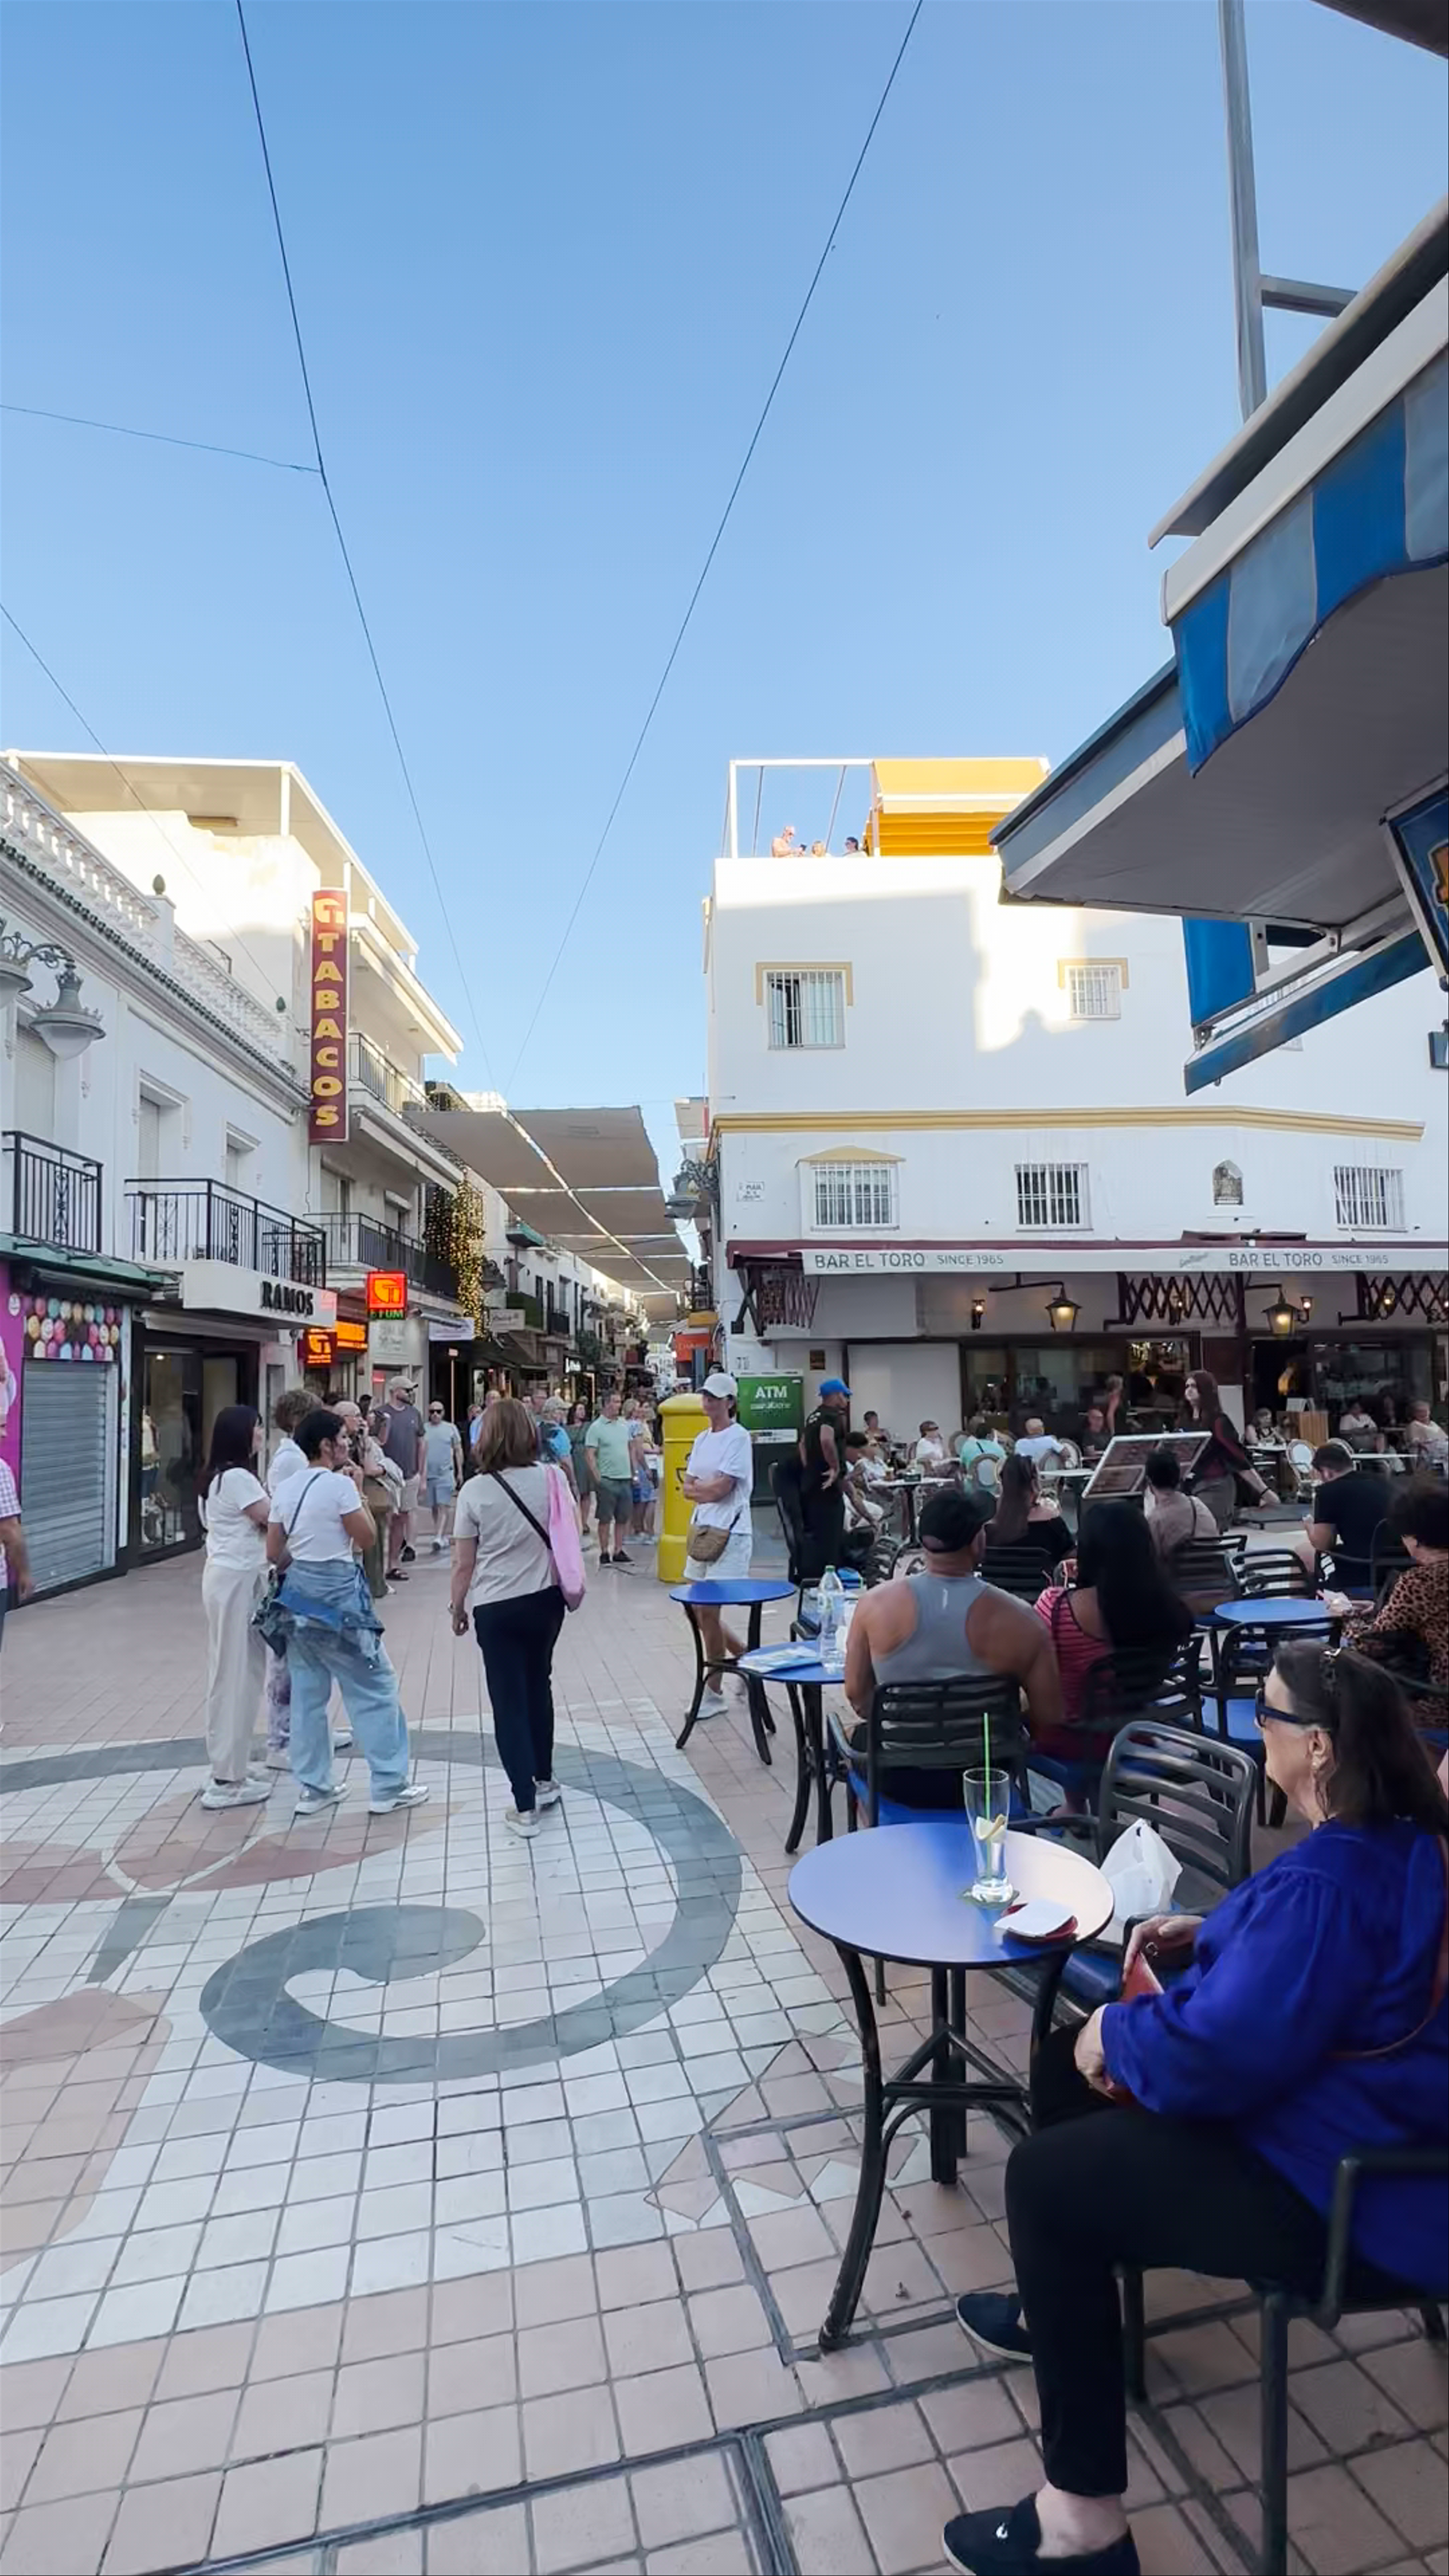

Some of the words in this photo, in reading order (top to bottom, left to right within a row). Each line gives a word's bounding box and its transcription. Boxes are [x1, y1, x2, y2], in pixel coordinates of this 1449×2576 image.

[313, 932, 343, 1126] TABACOS
[814, 1254, 849, 1268] BAR
[855, 1254, 874, 1267] EL
[879, 1252, 925, 1267] TORO
[937, 1255, 974, 1265] SINCE
[978, 1255, 1004, 1264] 1965
[1229, 1253, 1258, 1266] BAR
[1263, 1253, 1280, 1267] EL
[1283, 1253, 1322, 1267] TORO
[1332, 1255, 1362, 1264] SINCE
[261, 1280, 314, 1316] RAMOS
[755, 1385, 788, 1398] ATM
